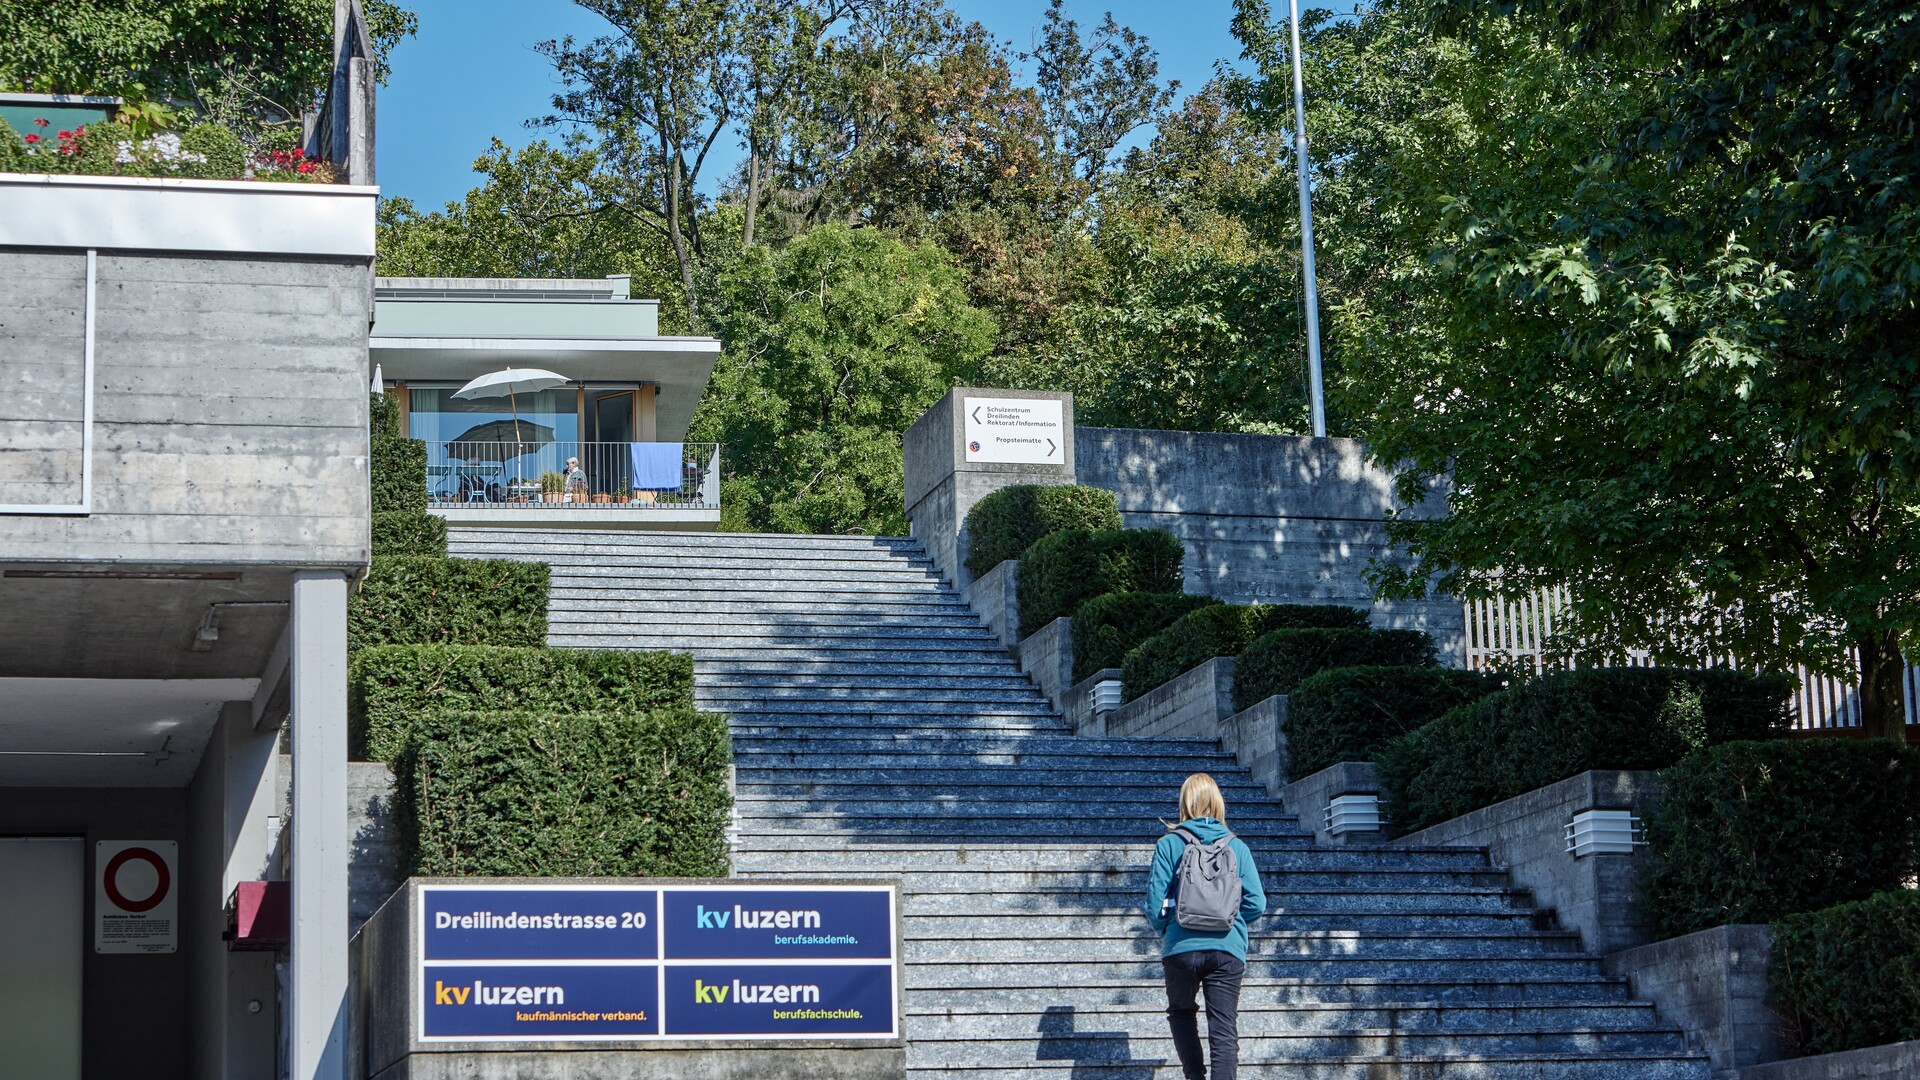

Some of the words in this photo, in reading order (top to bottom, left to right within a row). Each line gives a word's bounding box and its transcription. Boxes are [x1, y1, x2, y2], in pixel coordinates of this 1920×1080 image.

[996, 436, 1042, 444] Propsteimatte
[435, 911, 617, 930] Dreilindenstrasse
[621, 911, 647, 930] 20
[774, 934, 859, 946] berufsakademie.
[516, 1010, 600, 1022] kaufmännischer
[601, 1010, 648, 1022] verband.
[773, 1008, 863, 1020] berufsfachschule.
